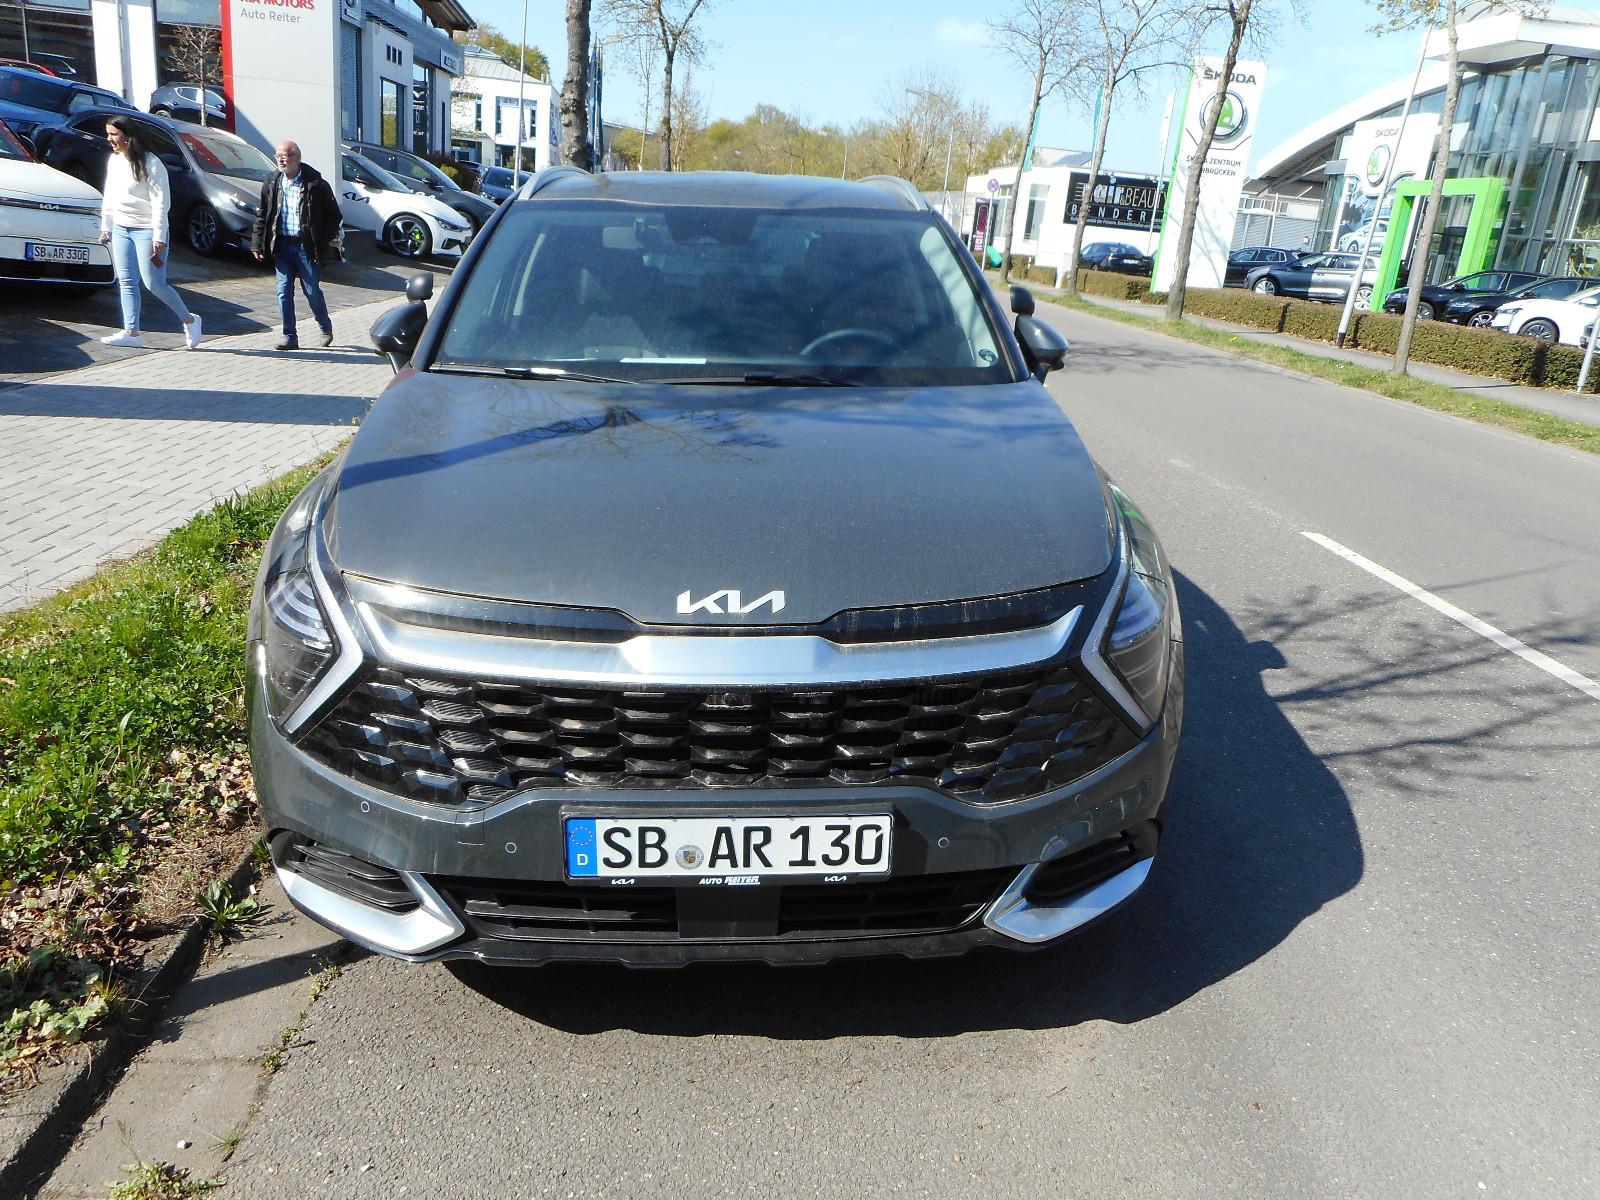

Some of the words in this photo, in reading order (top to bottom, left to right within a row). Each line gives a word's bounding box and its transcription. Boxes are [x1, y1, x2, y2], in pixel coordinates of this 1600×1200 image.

[240, 8, 266, 20] Auto
[269, 11, 302, 23] Reiter
[1209, 157, 1241, 167] ZENTRUM
[34, 246, 46, 258] SB
[52, 247, 65, 260] AR
[67, 248, 88, 261] 330E
[676, 589, 786, 614] KIA
[576, 853, 588, 867] D
[602, 826, 668, 868] SB
[708, 826, 772, 868] AR
[788, 824, 884, 867] 130
[699, 877, 723, 886] AUTO
